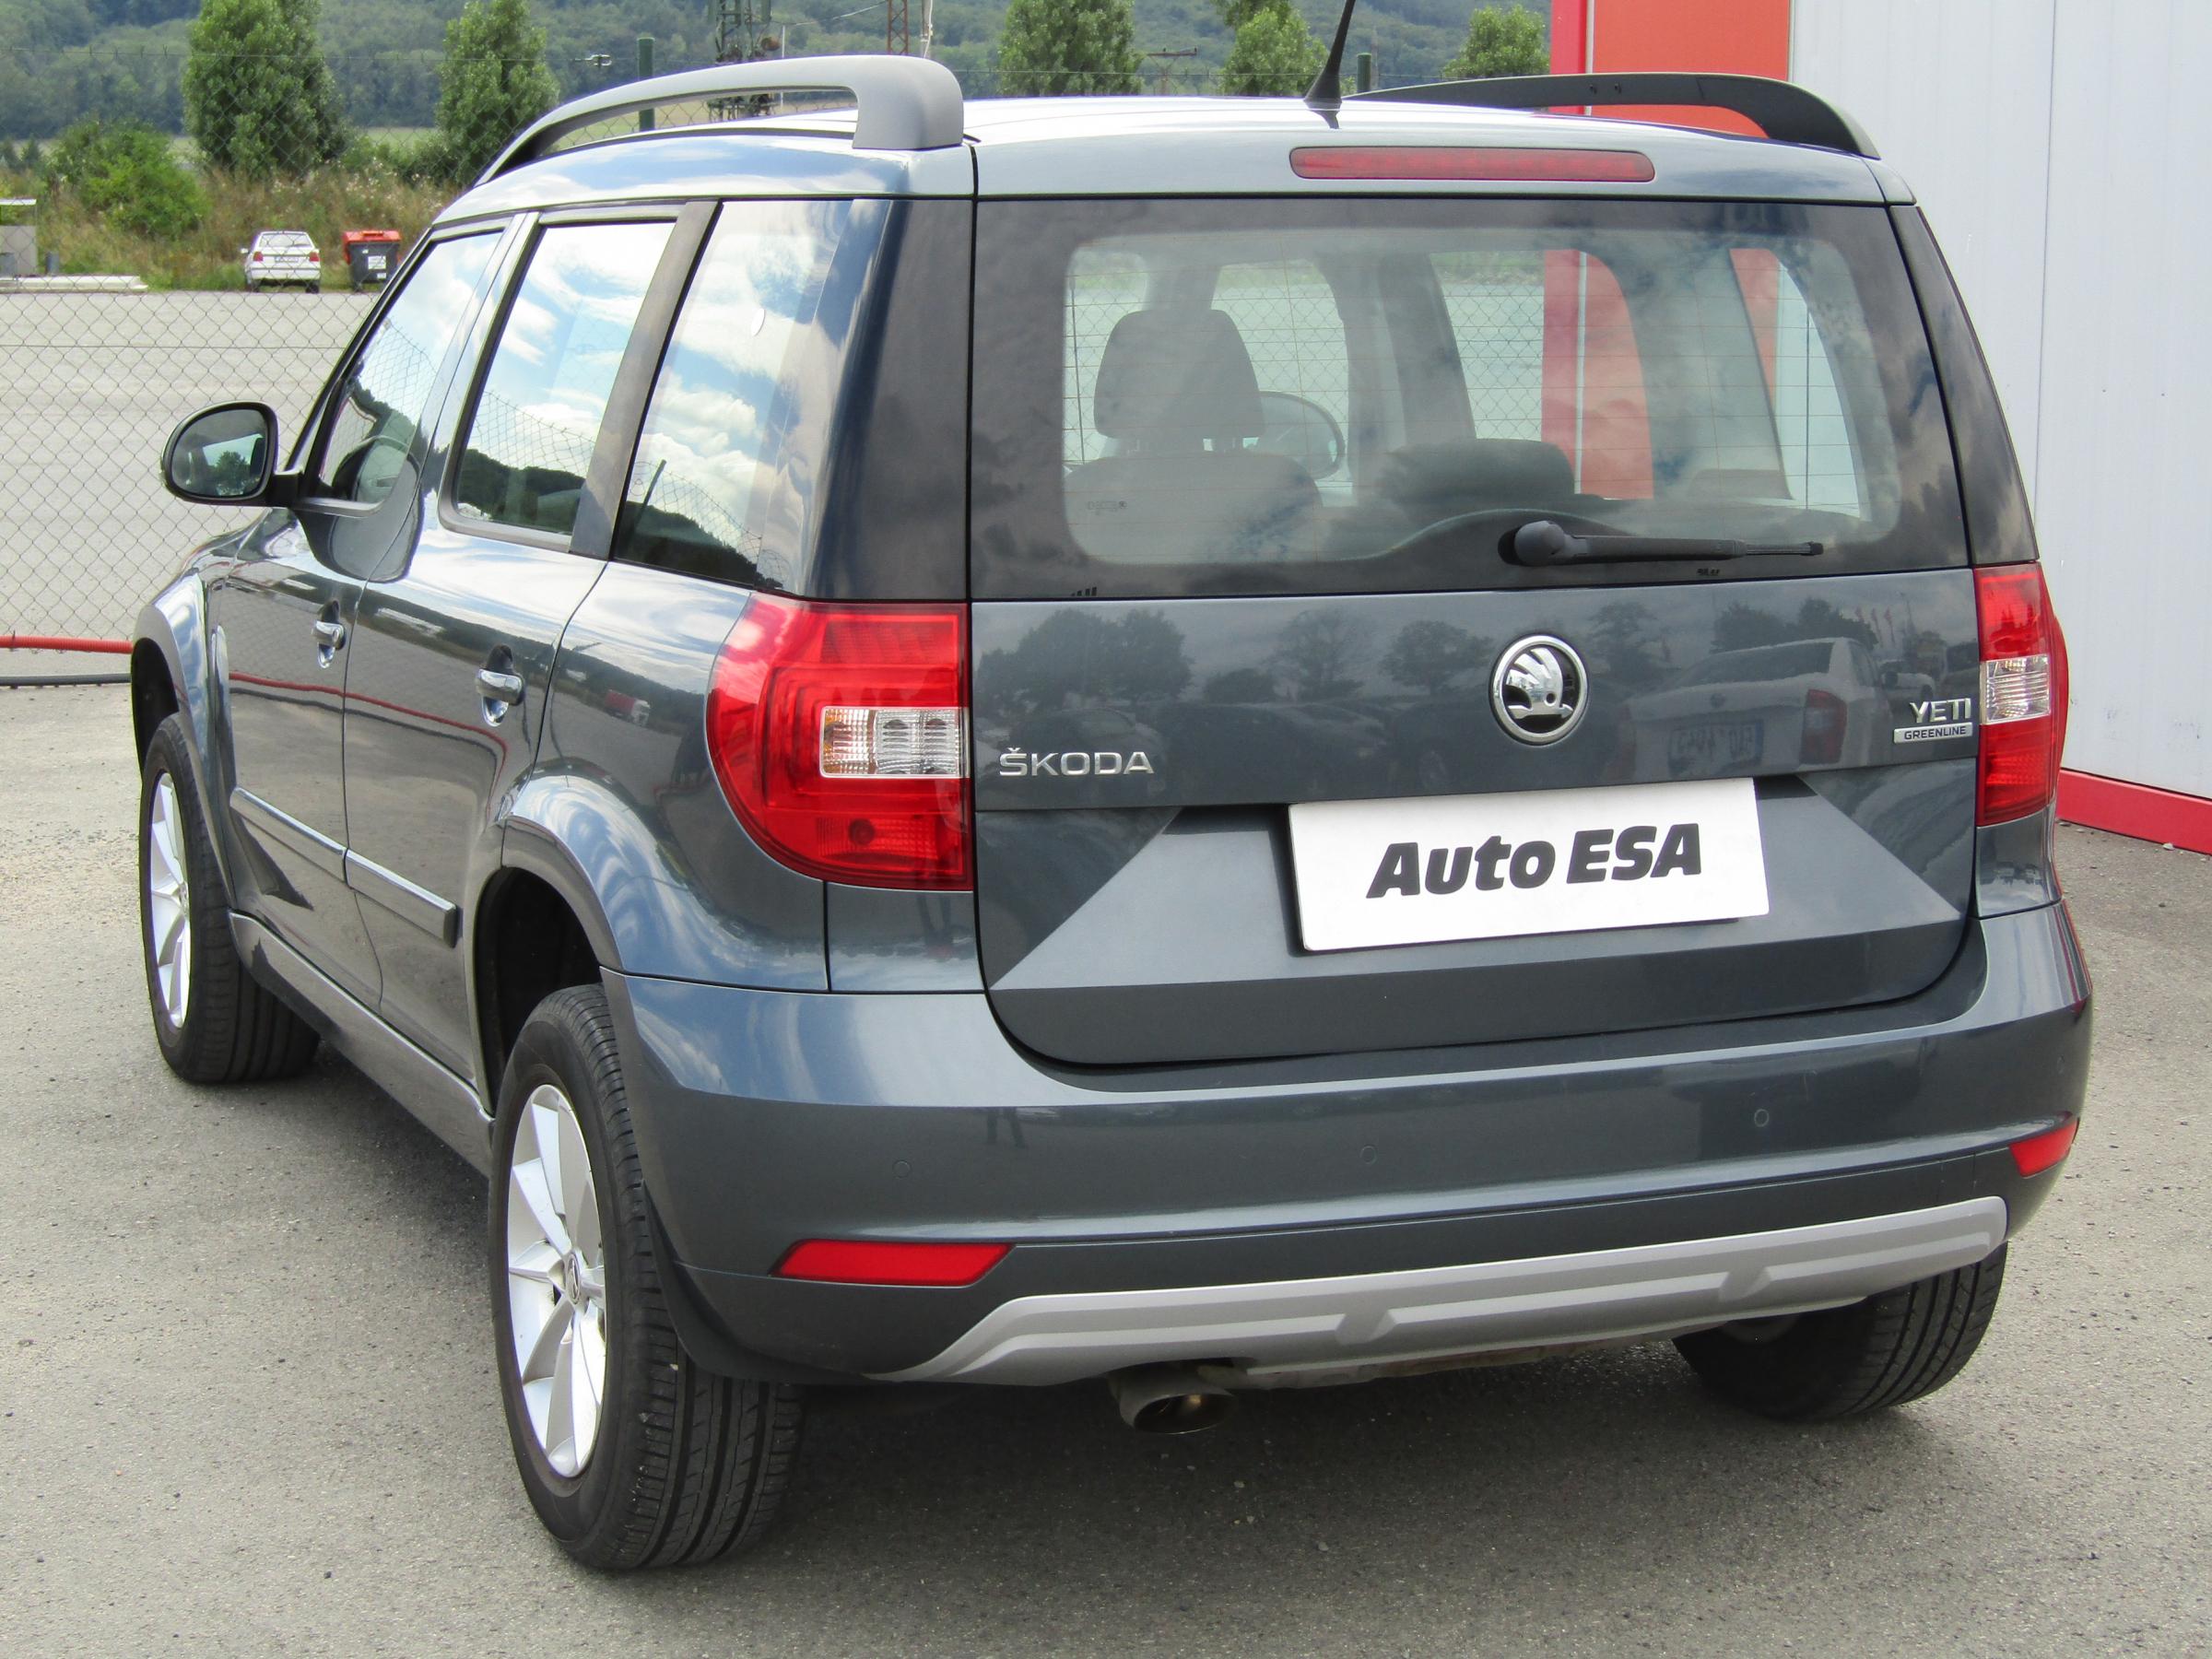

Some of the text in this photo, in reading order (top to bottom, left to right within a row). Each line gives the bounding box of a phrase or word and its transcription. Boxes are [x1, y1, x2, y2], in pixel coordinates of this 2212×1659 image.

[1909, 698, 1971, 724] YETI
[1903, 725, 1967, 740] GREENLINE
[999, 747, 1155, 776] ŠKODA
[1366, 823, 1701, 899] Auto ESA
